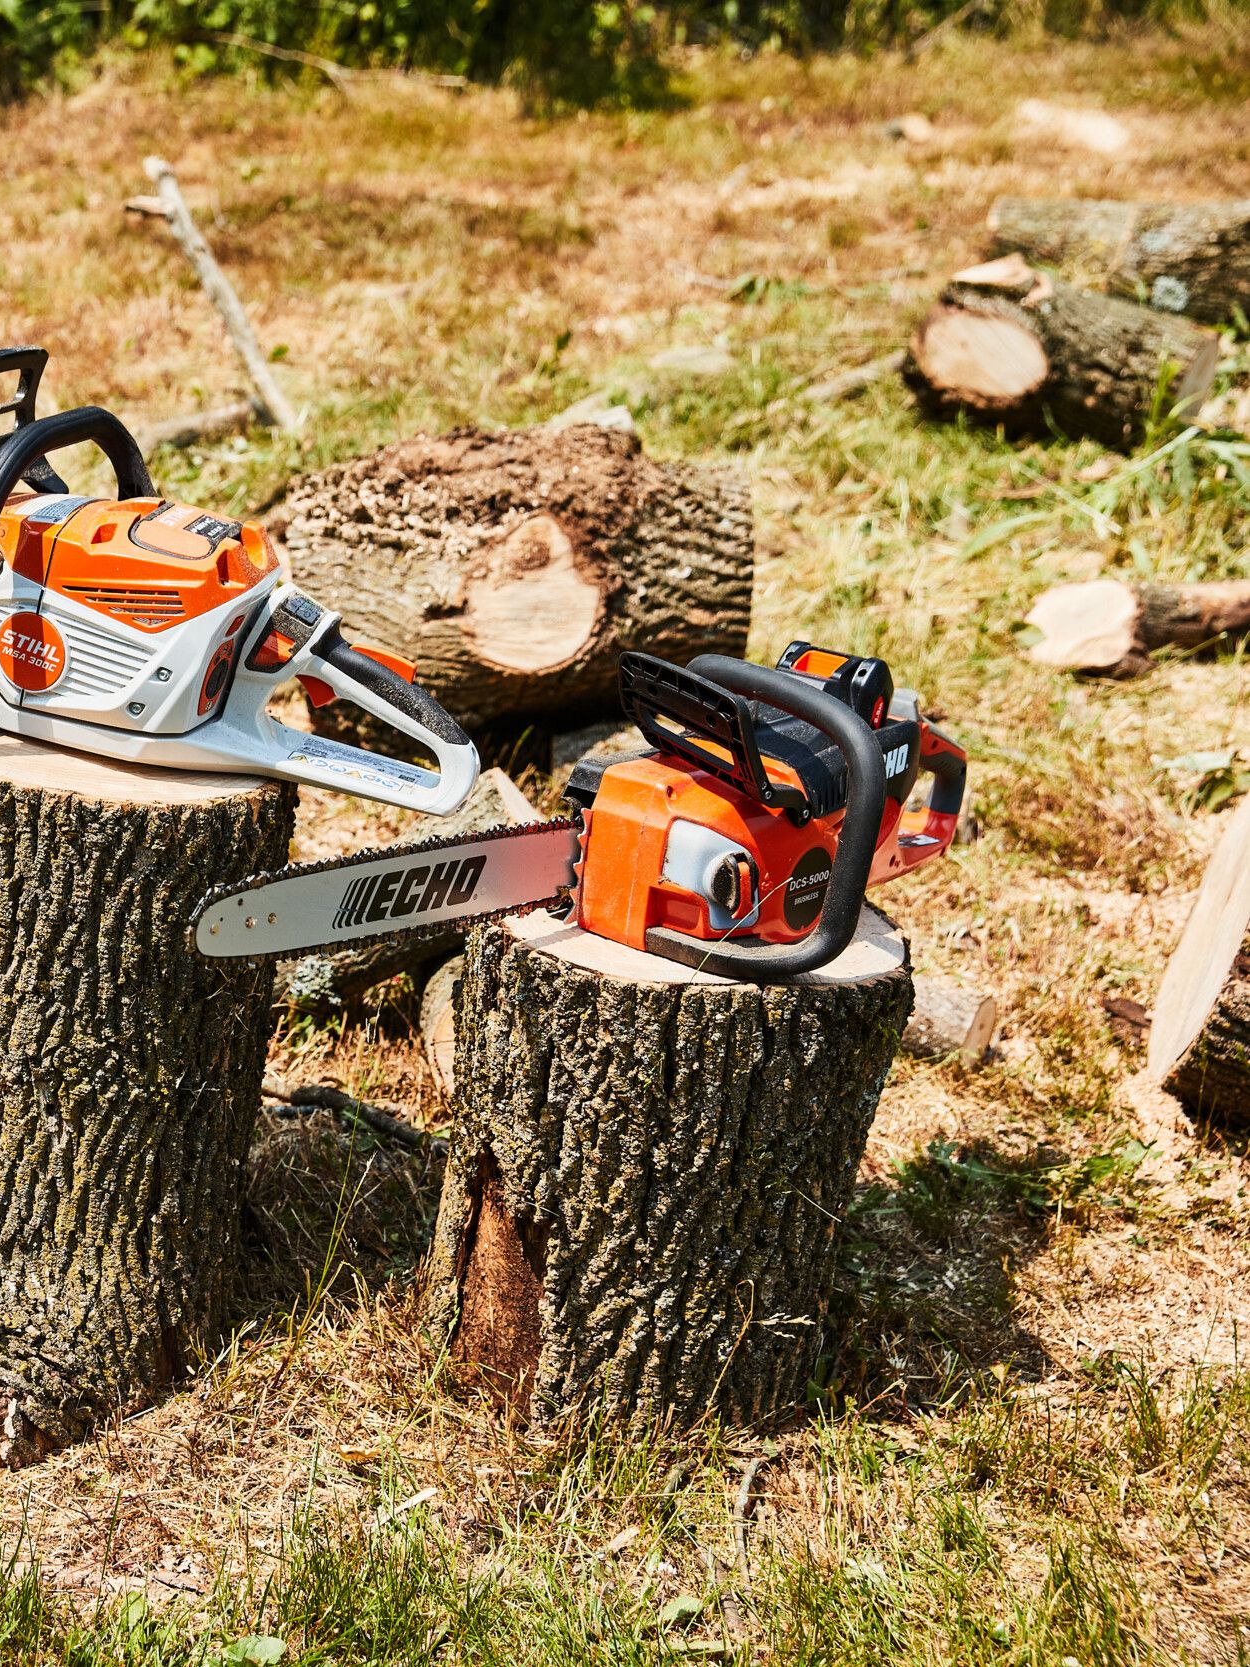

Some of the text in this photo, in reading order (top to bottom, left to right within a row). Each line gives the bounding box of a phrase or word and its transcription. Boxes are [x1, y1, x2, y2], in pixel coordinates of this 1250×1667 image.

[0, 629, 60, 663] STIHL
[2, 646, 57, 672] MSA 300C
[366, 855, 487, 923] ECHO
[789, 869, 830, 892] DCS-5000
